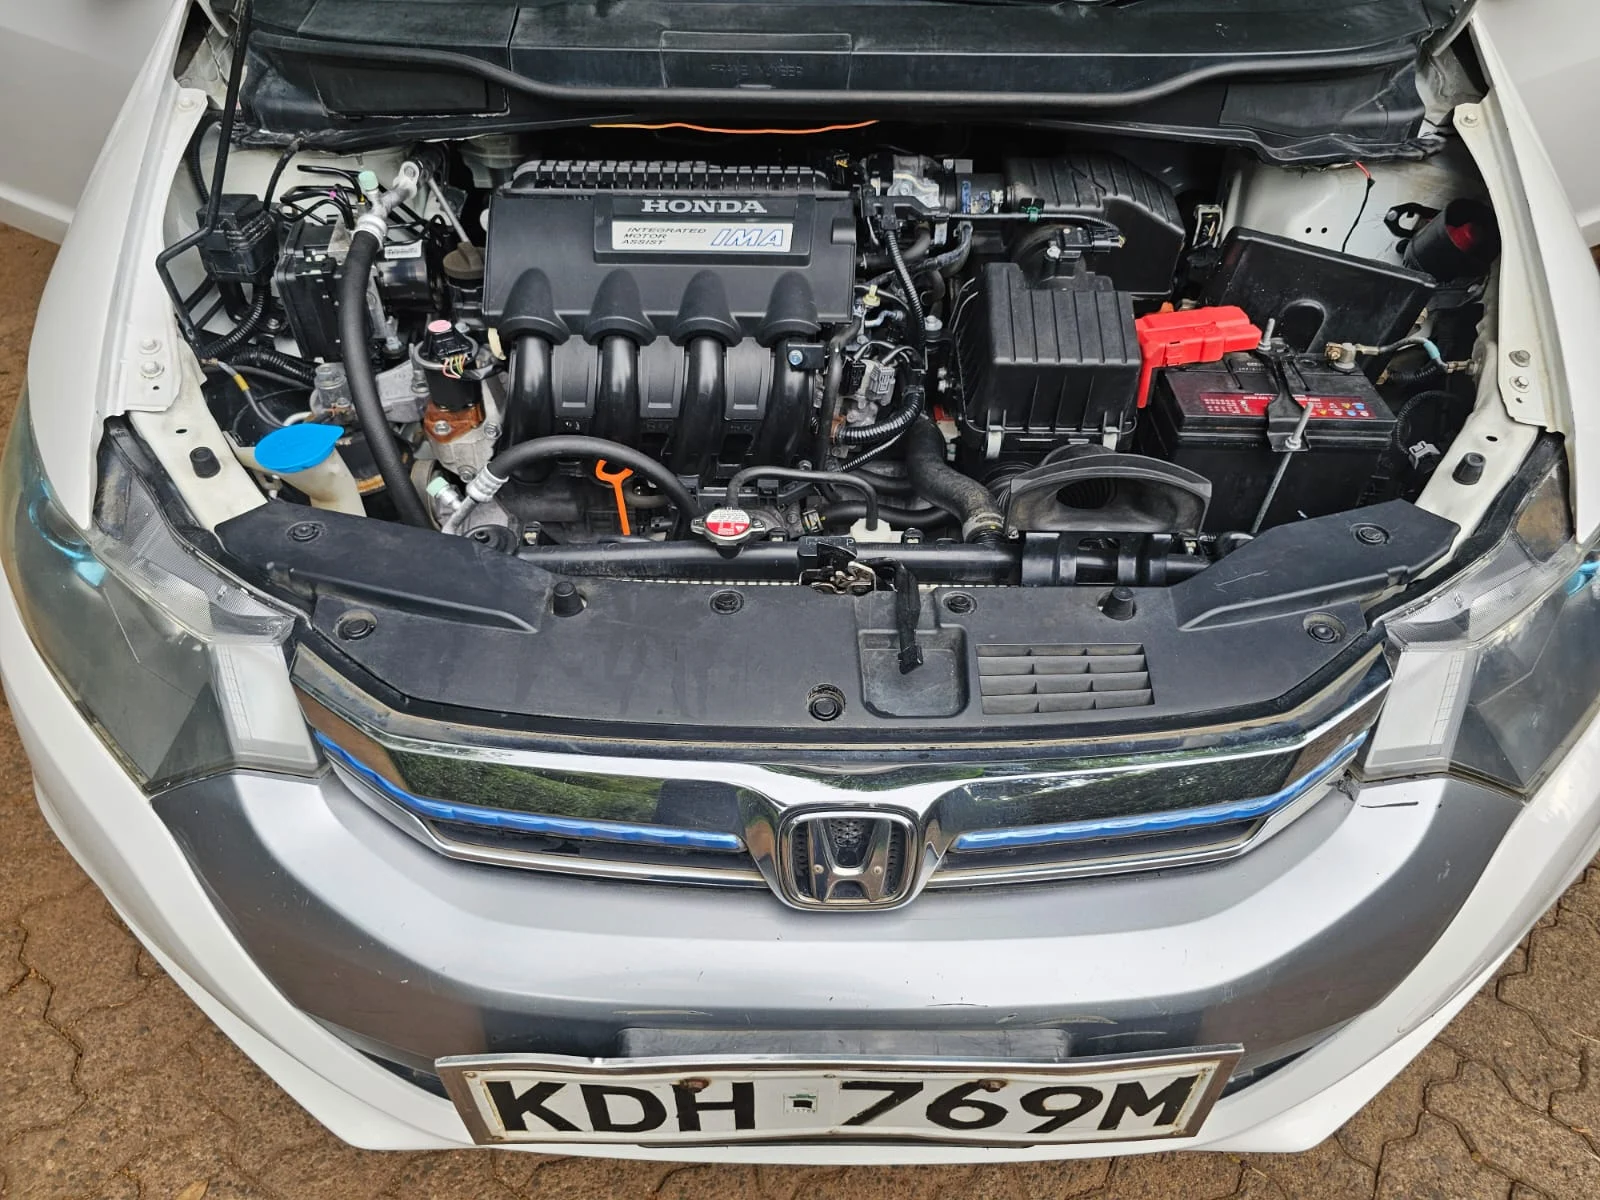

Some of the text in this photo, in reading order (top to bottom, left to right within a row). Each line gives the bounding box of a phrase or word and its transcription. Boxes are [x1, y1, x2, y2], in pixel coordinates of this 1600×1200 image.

[641, 199, 768, 214] HONDA
[710, 228, 784, 247] IMA
[484, 1075, 1201, 1134] KDH 769M
